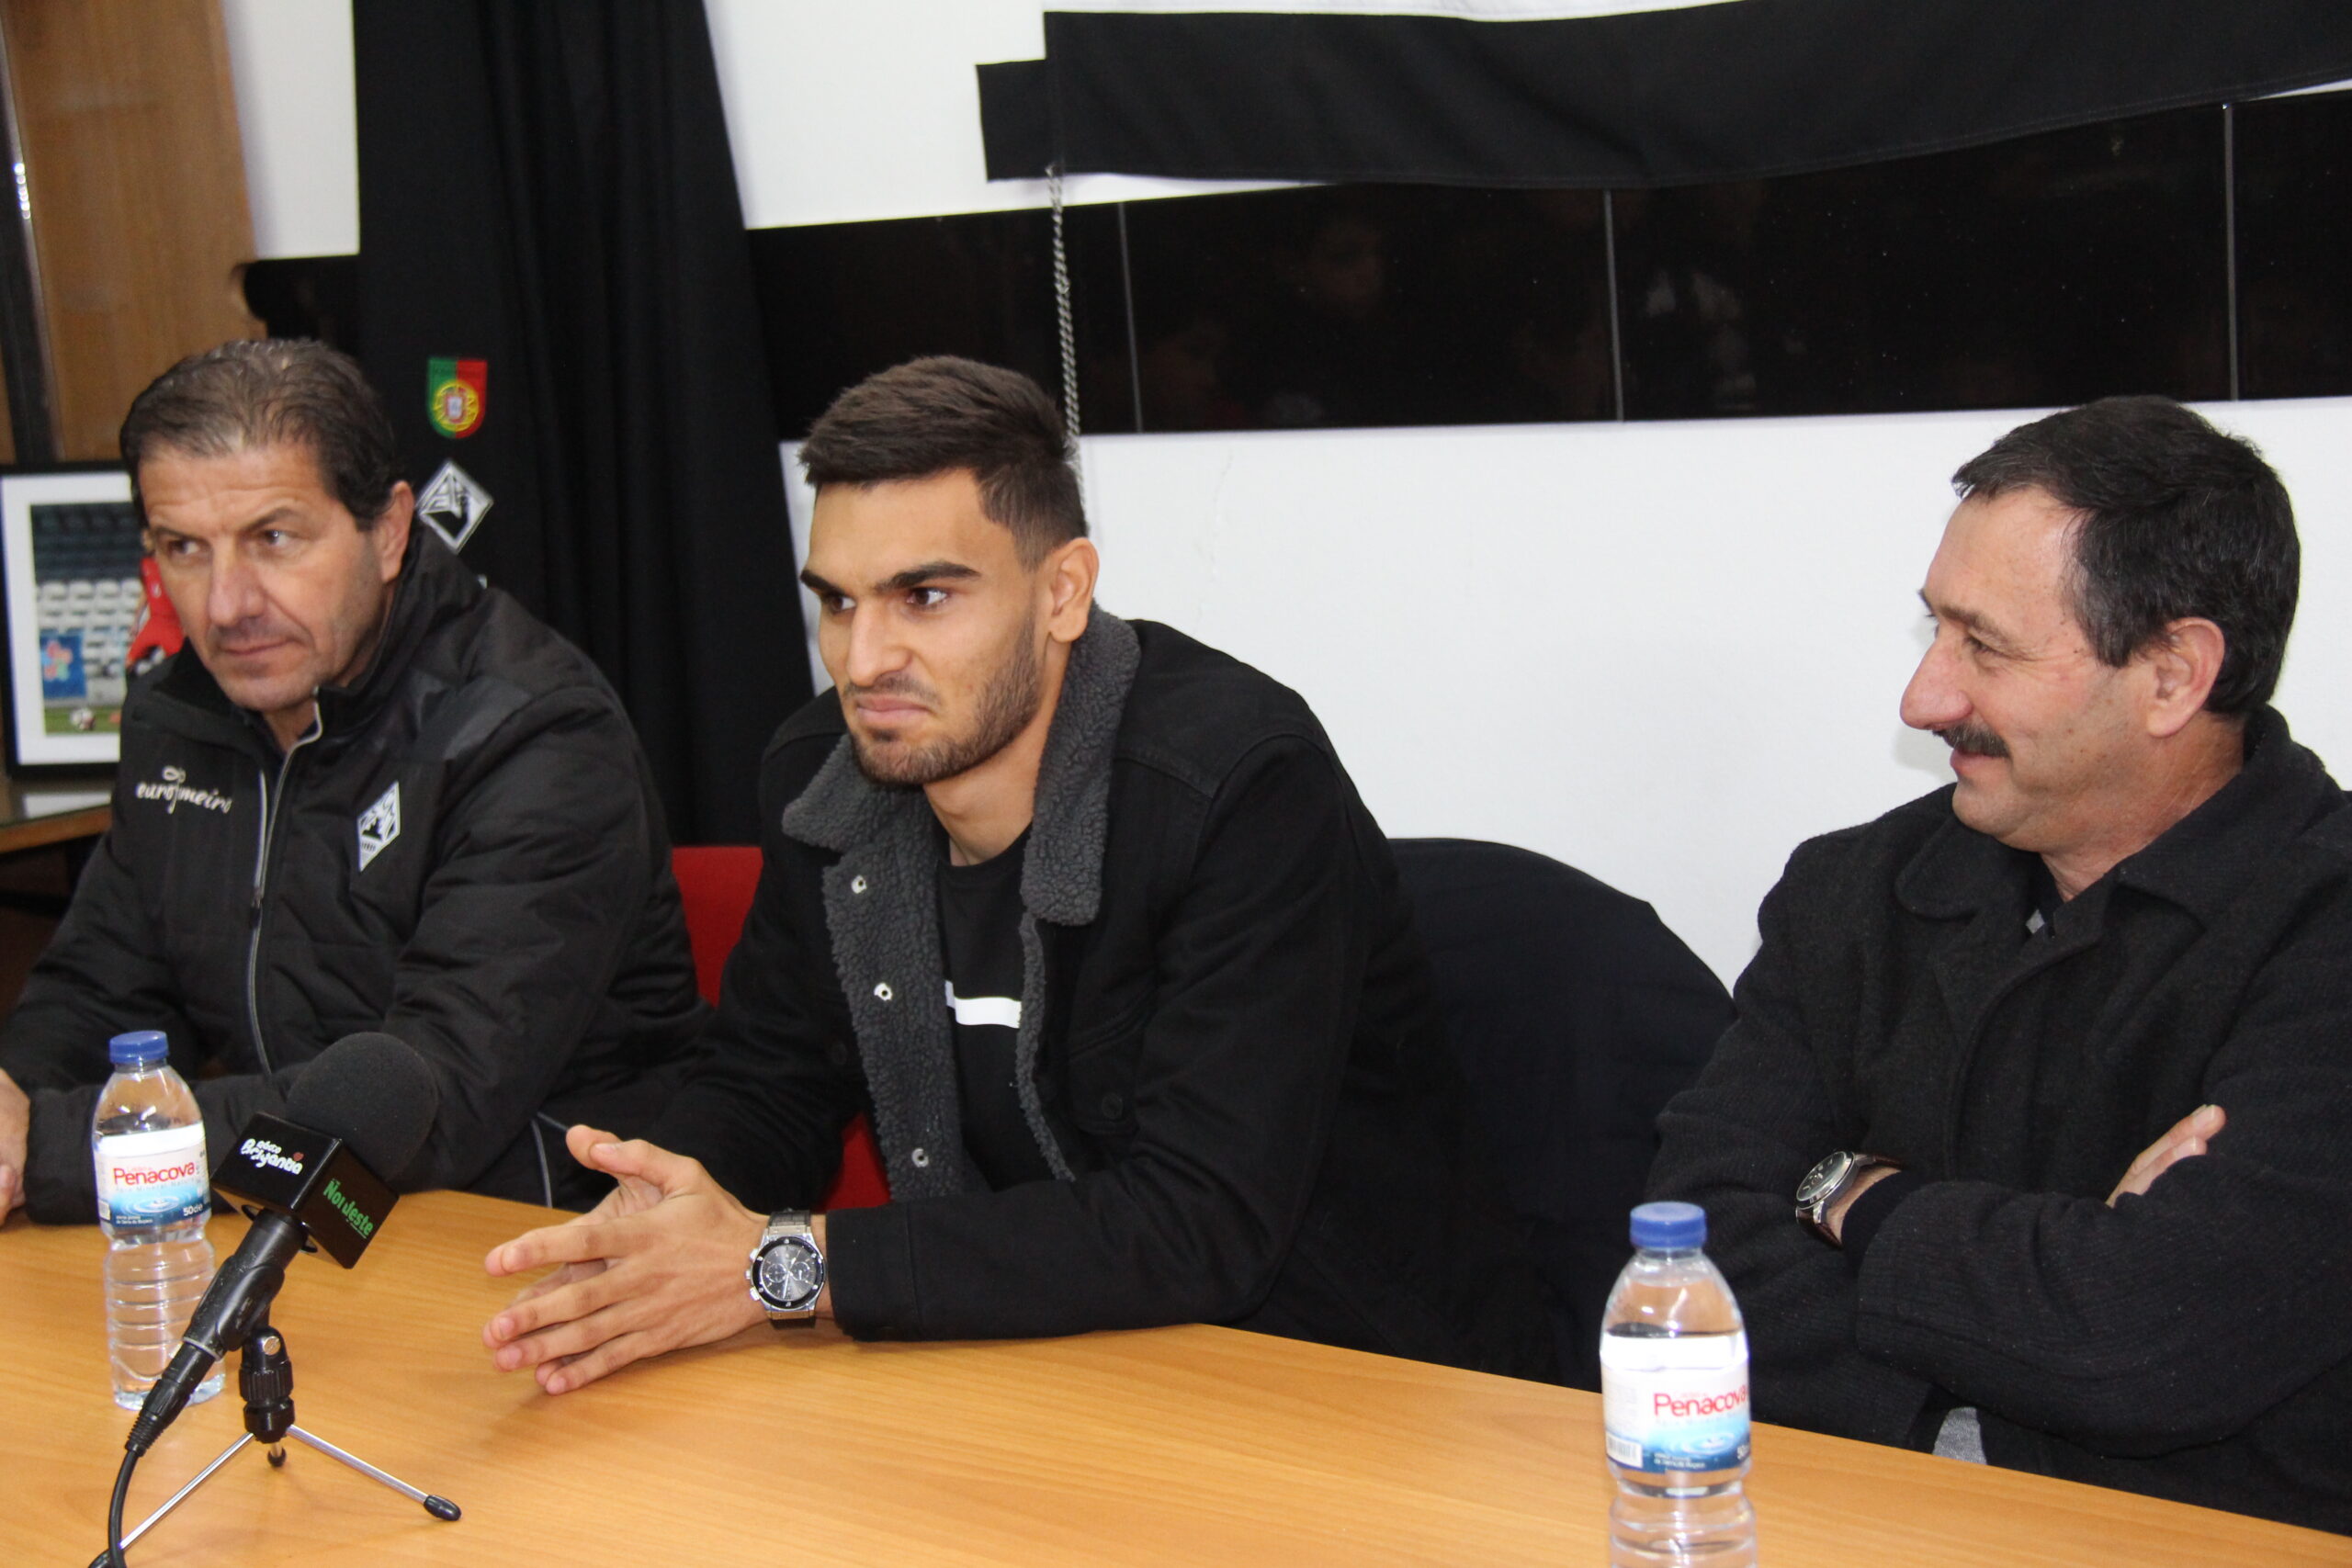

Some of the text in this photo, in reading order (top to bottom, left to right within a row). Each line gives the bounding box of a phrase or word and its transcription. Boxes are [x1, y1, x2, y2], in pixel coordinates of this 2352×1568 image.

[113, 1161, 196, 1185] Penacova
[323, 1179, 374, 1235] Nordeste
[1654, 1384, 1749, 1416] Penacova
